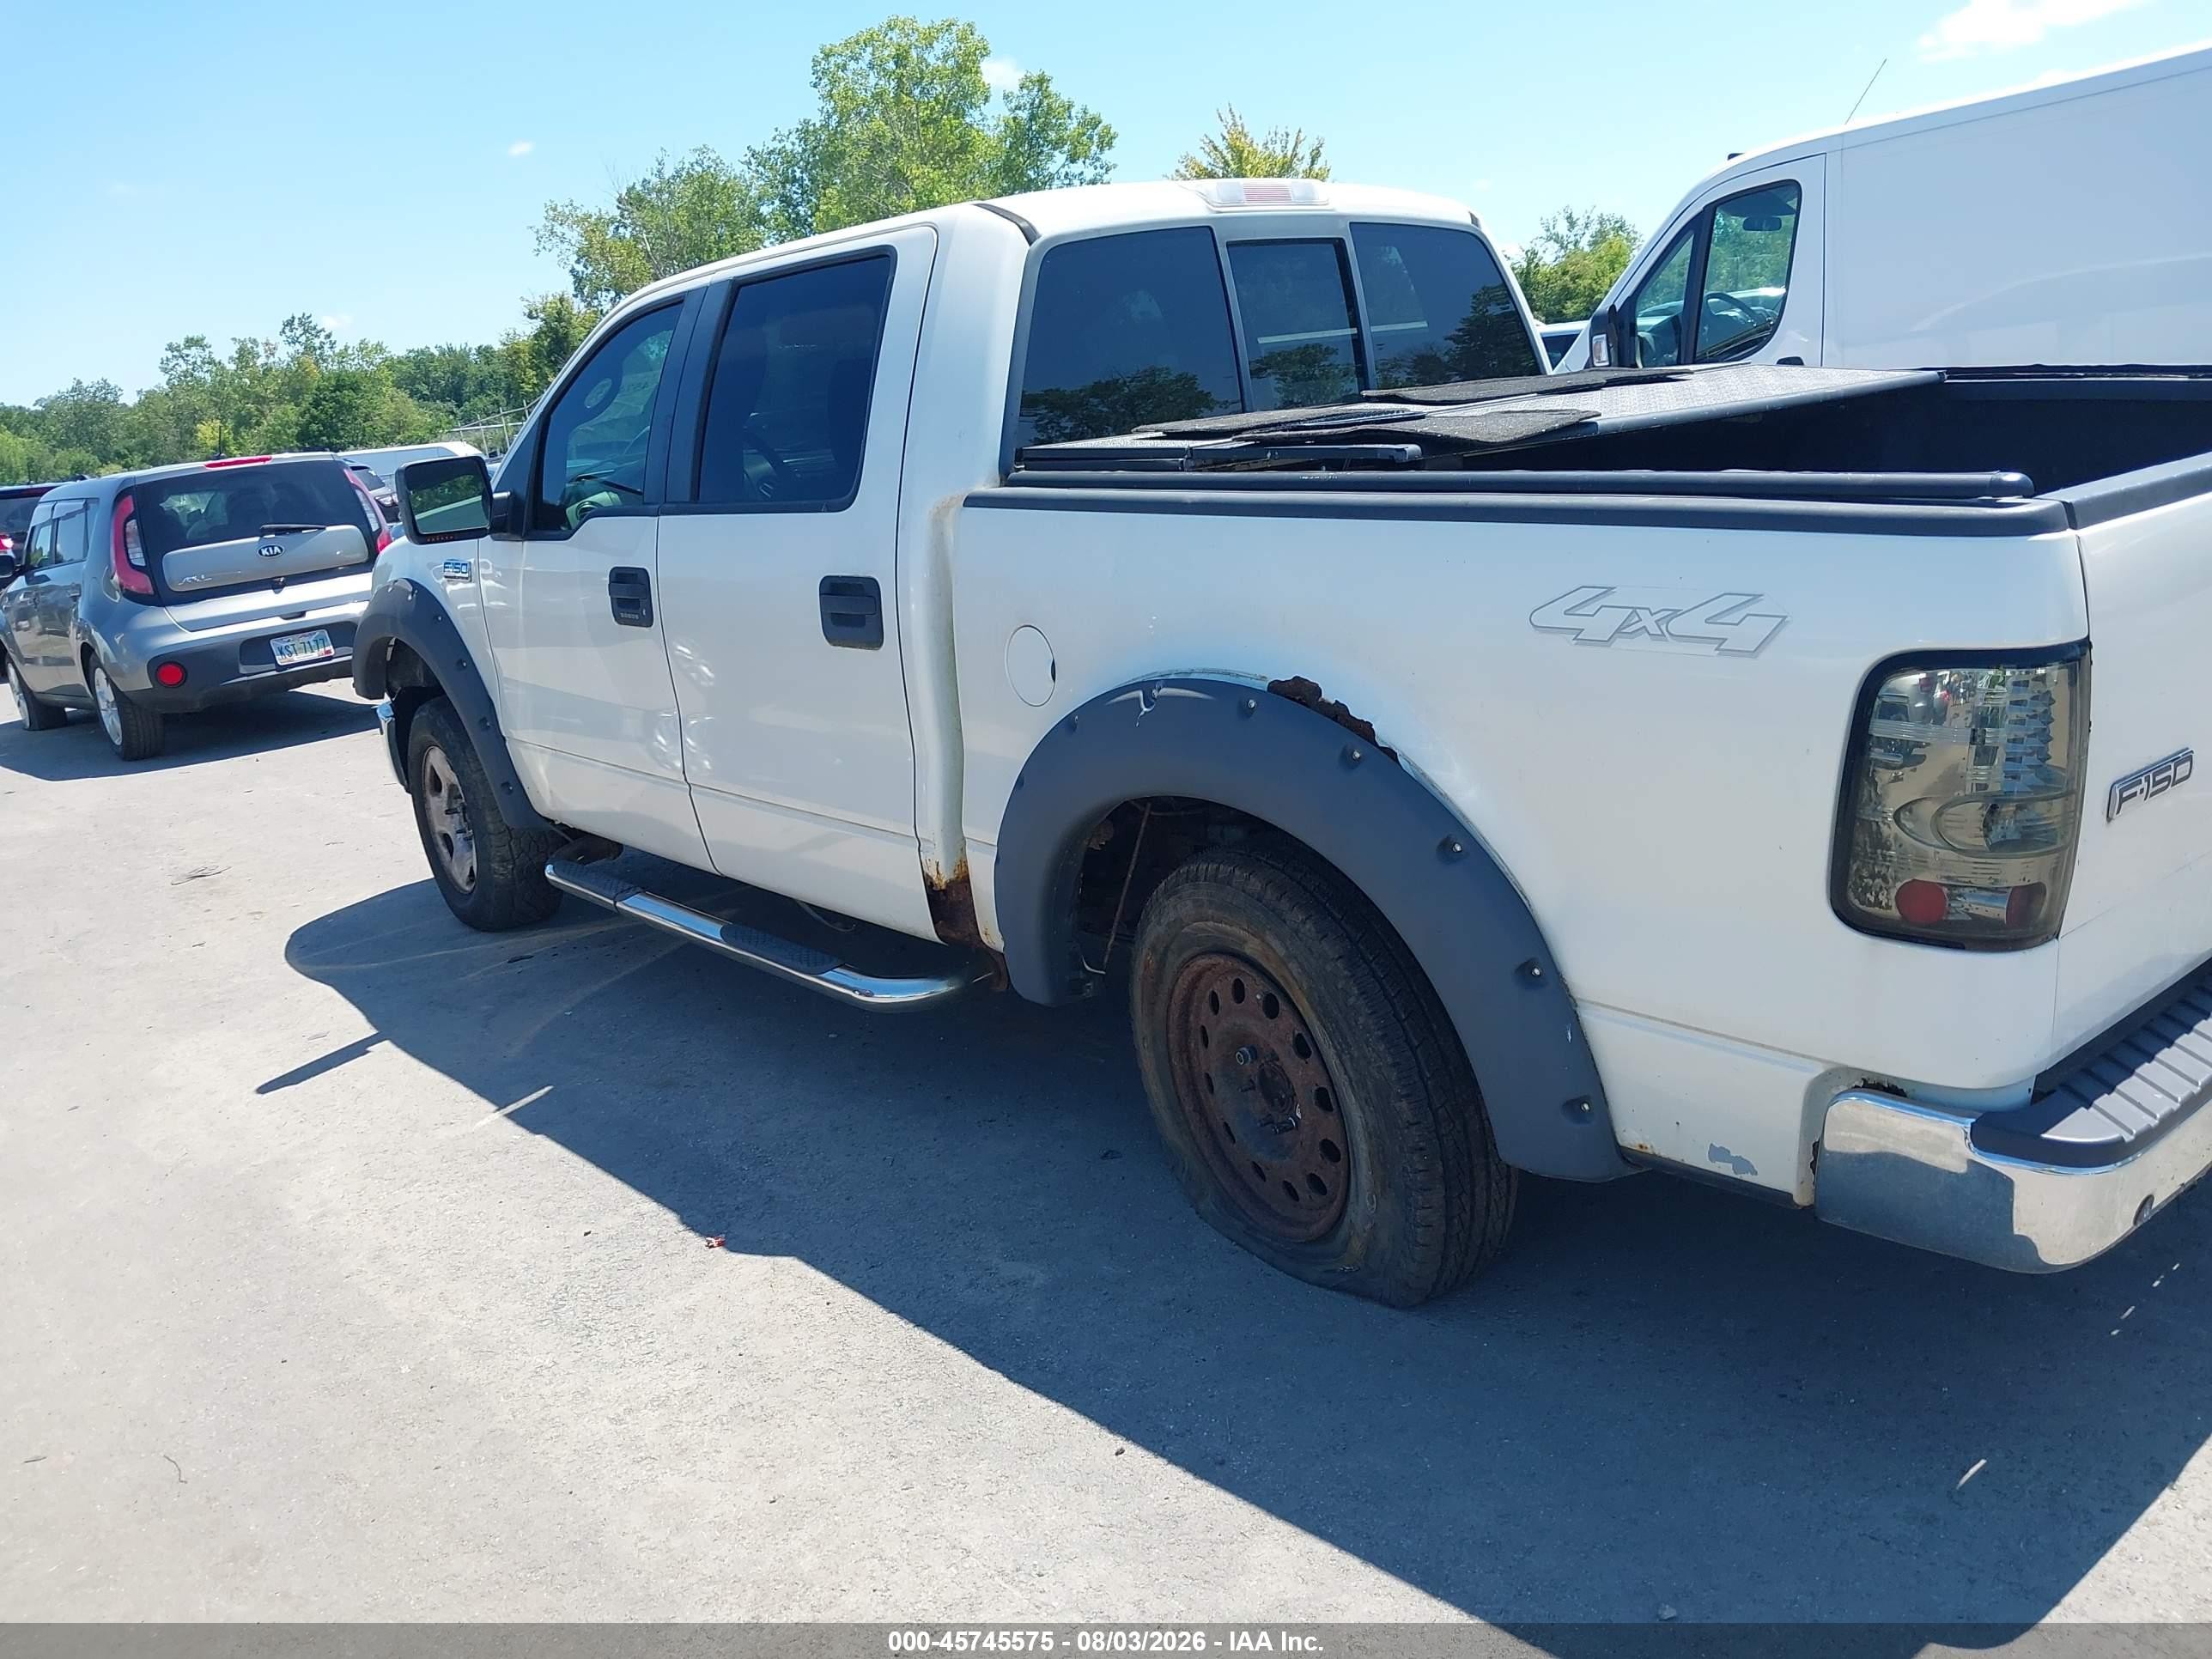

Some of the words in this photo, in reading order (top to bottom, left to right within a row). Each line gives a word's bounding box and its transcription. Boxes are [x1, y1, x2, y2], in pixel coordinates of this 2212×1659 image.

[261, 546, 282, 556] KIA
[1529, 586, 1789, 654] 4x4
[277, 643, 298, 659] KST
[300, 638, 326, 654] 7177
[2115, 754, 2193, 816] F-150
